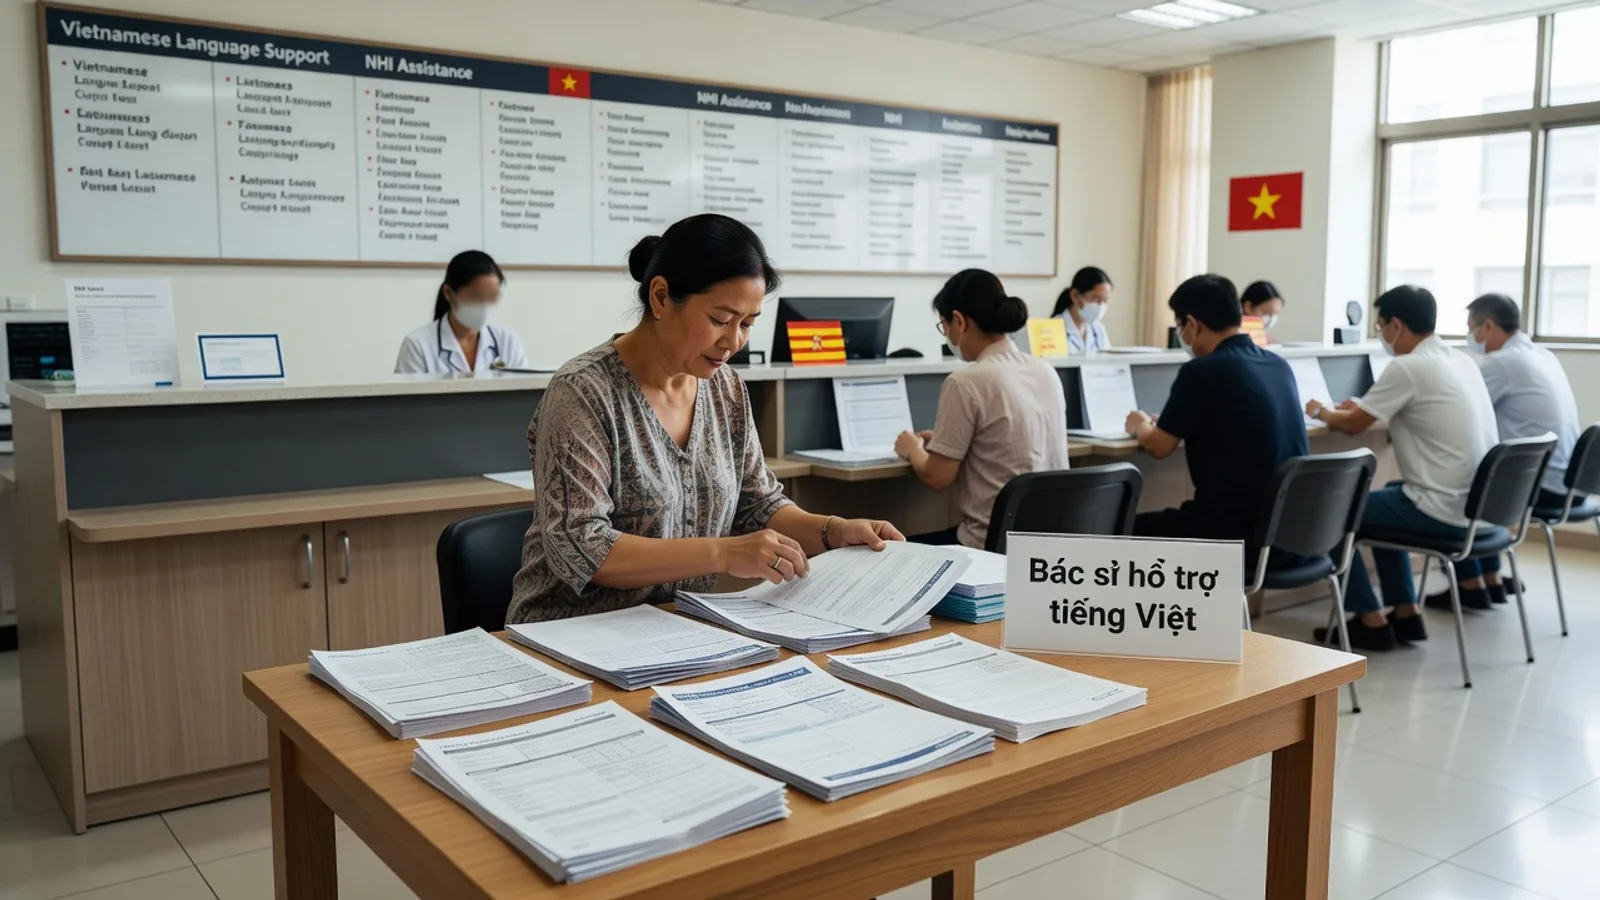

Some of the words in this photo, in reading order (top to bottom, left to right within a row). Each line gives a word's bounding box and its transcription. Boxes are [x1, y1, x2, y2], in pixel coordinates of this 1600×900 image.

[60, 19, 171, 49] Vietnamese
[175, 32, 260, 60] Language
[264, 43, 331, 66] Support
[365, 54, 394, 71] NHI
[397, 58, 473, 80] Assistance
[1029, 557, 1085, 584] Bác
[1174, 566, 1219, 597] trợ
[1049, 597, 1126, 634] tiếng
[1135, 602, 1197, 636] Việt
